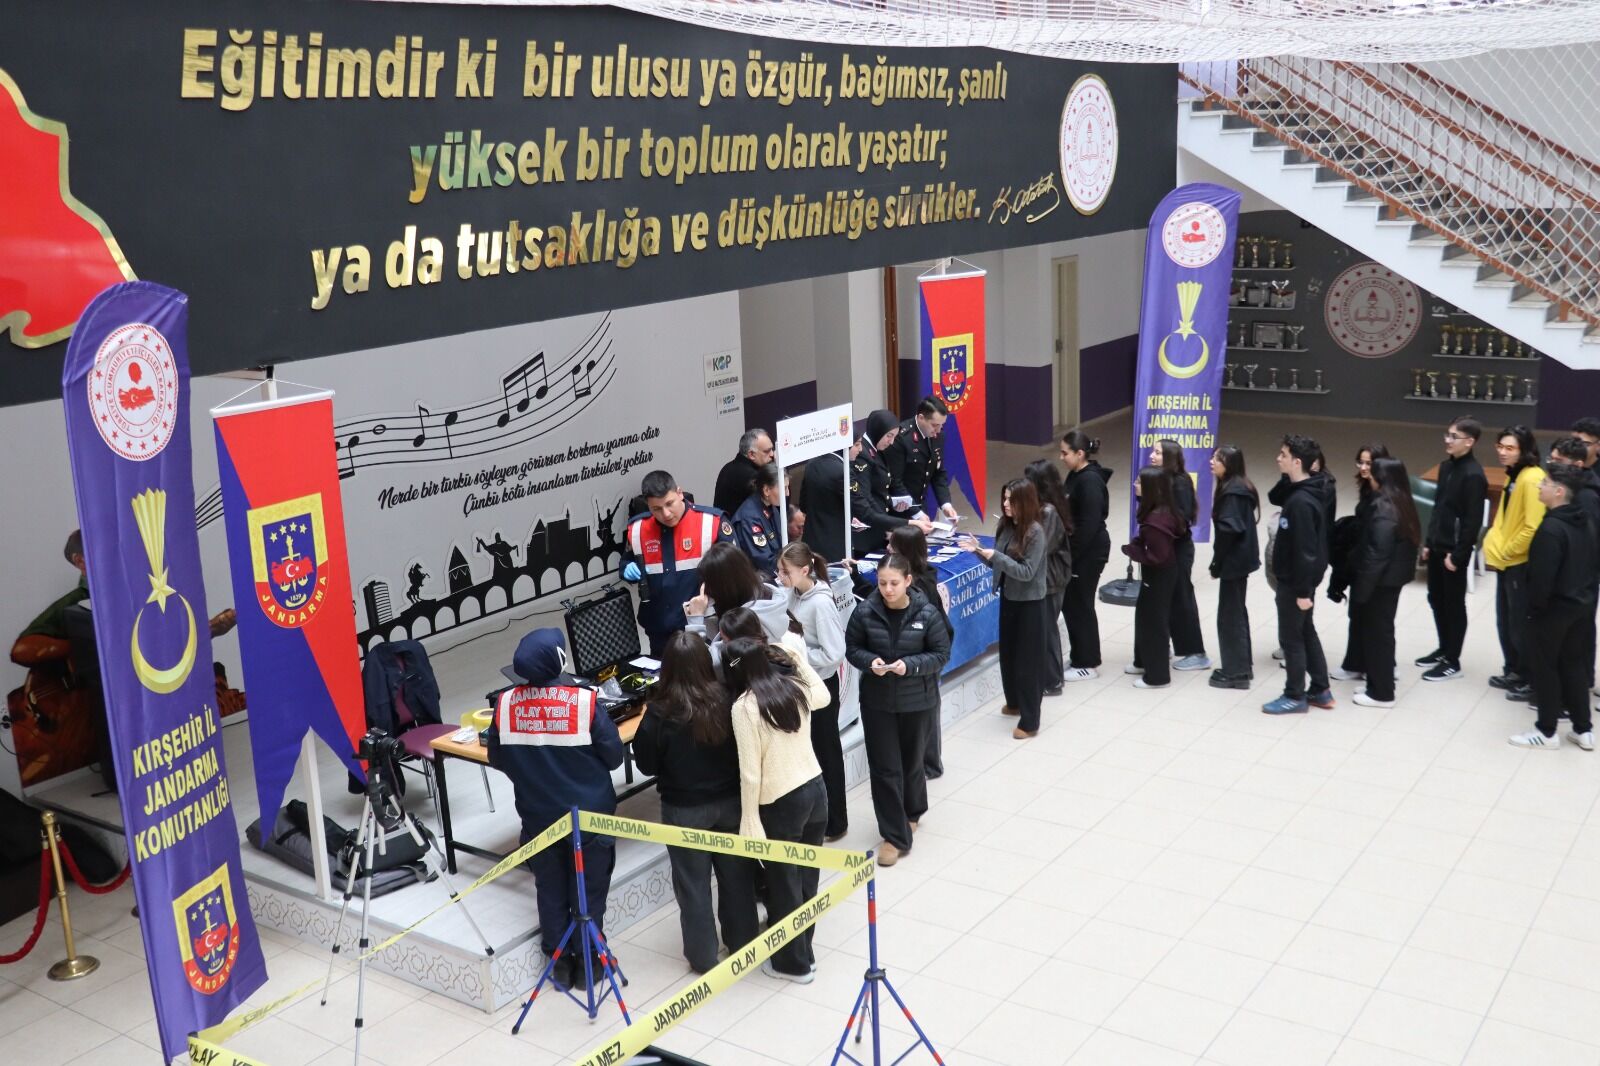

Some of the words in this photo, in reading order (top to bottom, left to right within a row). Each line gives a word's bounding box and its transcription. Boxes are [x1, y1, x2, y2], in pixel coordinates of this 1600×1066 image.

[181, 28, 445, 111] Eğitimdir
[455, 38, 497, 98] ki
[523, 40, 582, 98] bir
[591, 43, 691, 99] ulusu
[700, 56, 737, 107] ya
[745, 49, 833, 106] özgür,
[839, 53, 953, 107] bağımsız,
[958, 61, 1007, 106] şanlı
[409, 127, 568, 204] yüksek
[576, 126, 630, 181] bir
[640, 123, 759, 186] toplum
[765, 122, 852, 170] olarak
[857, 122, 948, 173] yaşatır;
[311, 246, 371, 310] ya
[385, 225, 444, 289] da
[457, 207, 660, 280] tutsaklığa
[671, 215, 708, 253] ve
[717, 189, 879, 251] düşkünlüğe
[883, 181, 981, 228] sürükler.
[1146, 392, 1200, 413] KIRŞEHİR
[1202, 392, 1213, 411] İL
[1148, 414, 1208, 430] JANDARMA
[378, 486, 419, 510] Nerde
[421, 480, 440, 499] bir
[440, 471, 474, 494] türkü
[473, 464, 519, 490] söyleyen
[517, 455, 566, 481] görürsen
[566, 442, 605, 462] korkma
[603, 433, 640, 458] yanına
[640, 425, 660, 442] otur
[463, 490, 500, 517] Çünkü
[526, 472, 580, 497] insanların
[580, 456, 622, 481] türküleri
[620, 449, 654, 475] yoktur
[262, 576, 327, 624] JANDARMA
[511, 686, 578, 705] JANDARMA
[514, 706, 541, 718] OLAY
[543, 703, 570, 718] YERİ
[516, 717, 568, 732] İNCELEME
[132, 706, 204, 779] KIRŞEHİR
[203, 703, 217, 734] İL
[143, 746, 219, 816] JANDARMA
[134, 775, 230, 863] KOMUTANLIĞI
[653, 981, 712, 1033] JANDARMA
[731, 946, 757, 976] OLAY
